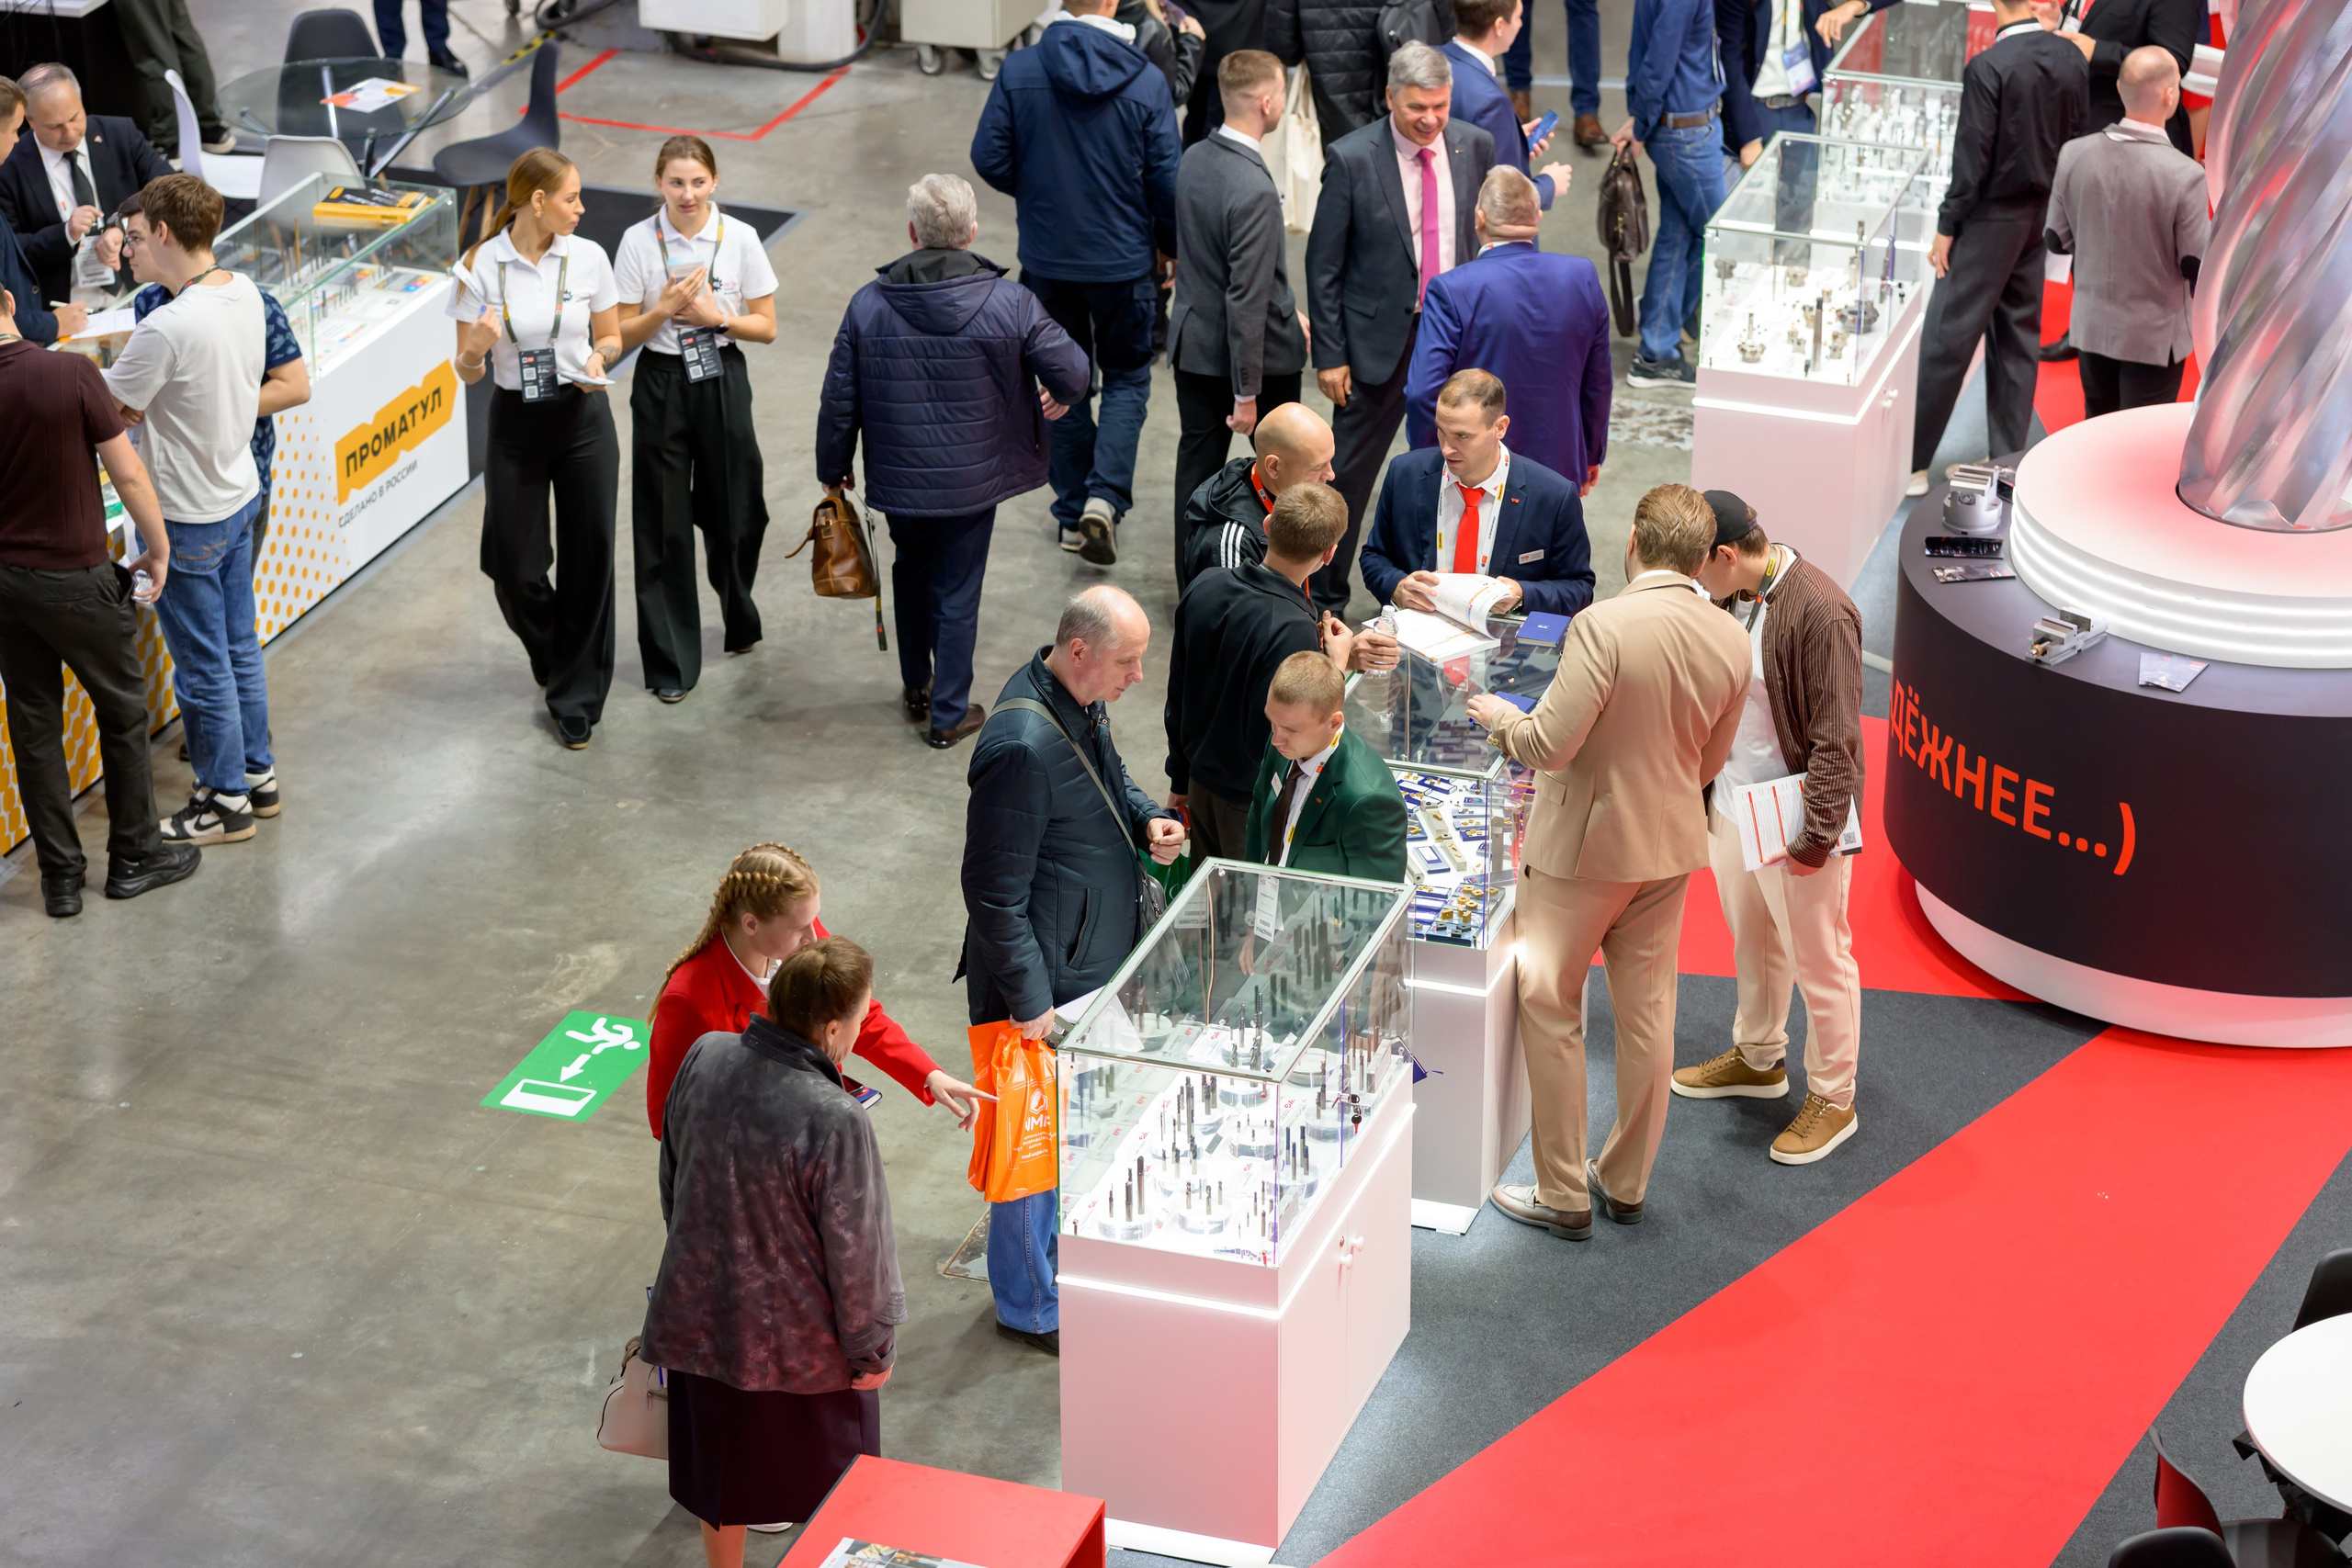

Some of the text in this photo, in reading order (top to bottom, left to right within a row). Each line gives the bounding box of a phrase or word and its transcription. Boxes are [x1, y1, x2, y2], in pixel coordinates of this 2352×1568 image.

[345, 386, 442, 478] ПРОМАТУЛ
[338, 459, 418, 528] СДЕЛАНО В РОССИИ
[1890, 679, 2136, 875] ДЁЖНЕЕ...)
